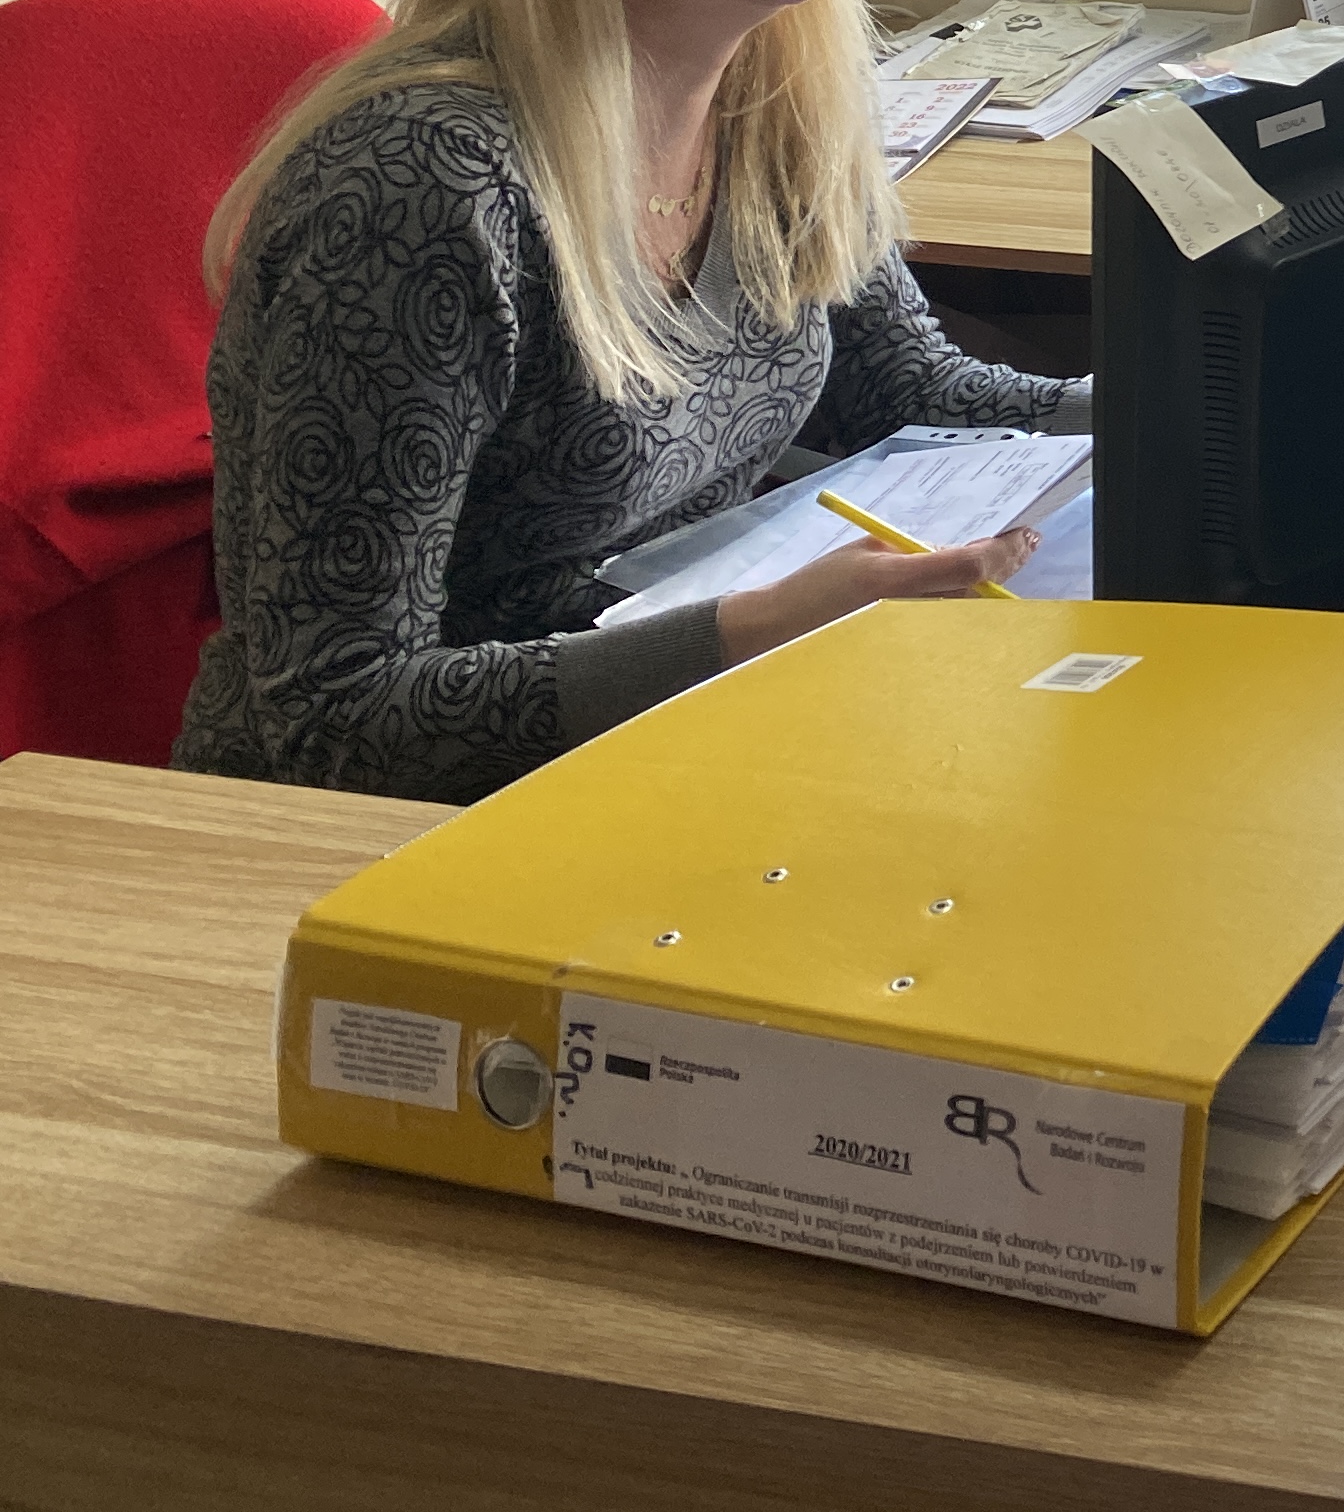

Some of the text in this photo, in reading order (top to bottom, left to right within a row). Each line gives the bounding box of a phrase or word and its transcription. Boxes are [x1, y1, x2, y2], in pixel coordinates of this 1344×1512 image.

[934, 82, 977, 91] 2022
[811, 1134, 912, 1174] 2020/2021
[572, 1140, 609, 1163] Tytuł
[611, 1150, 677, 1176] projektu:
[692, 1165, 780, 1197] Ograniczanie
[783, 1185, 849, 1215] transmisji
[853, 1202, 978, 1239] rozprzestrzeniania
[981, 1226, 1002, 1247] się
[1004, 1232, 1062, 1260] choroby
[1066, 1245, 1147, 1273] COVID-19
[1150, 1263, 1165, 1276] w
[595, 1168, 664, 1196] codziennej
[668, 1185, 725, 1207] praktyce
[728, 1194, 800, 1224] medycznej
[816, 1215, 885, 1240] pacjentów
[901, 1235, 993, 1263] podejrzeniem
[998, 1251, 1021, 1268] lub
[1024, 1260, 1137, 1294] potwierdzeniem
[686, 1205, 776, 1238] SARS-CoV-2
[781, 1228, 834, 1251] podczas
[838, 1238, 912, 1266] konsultacji
